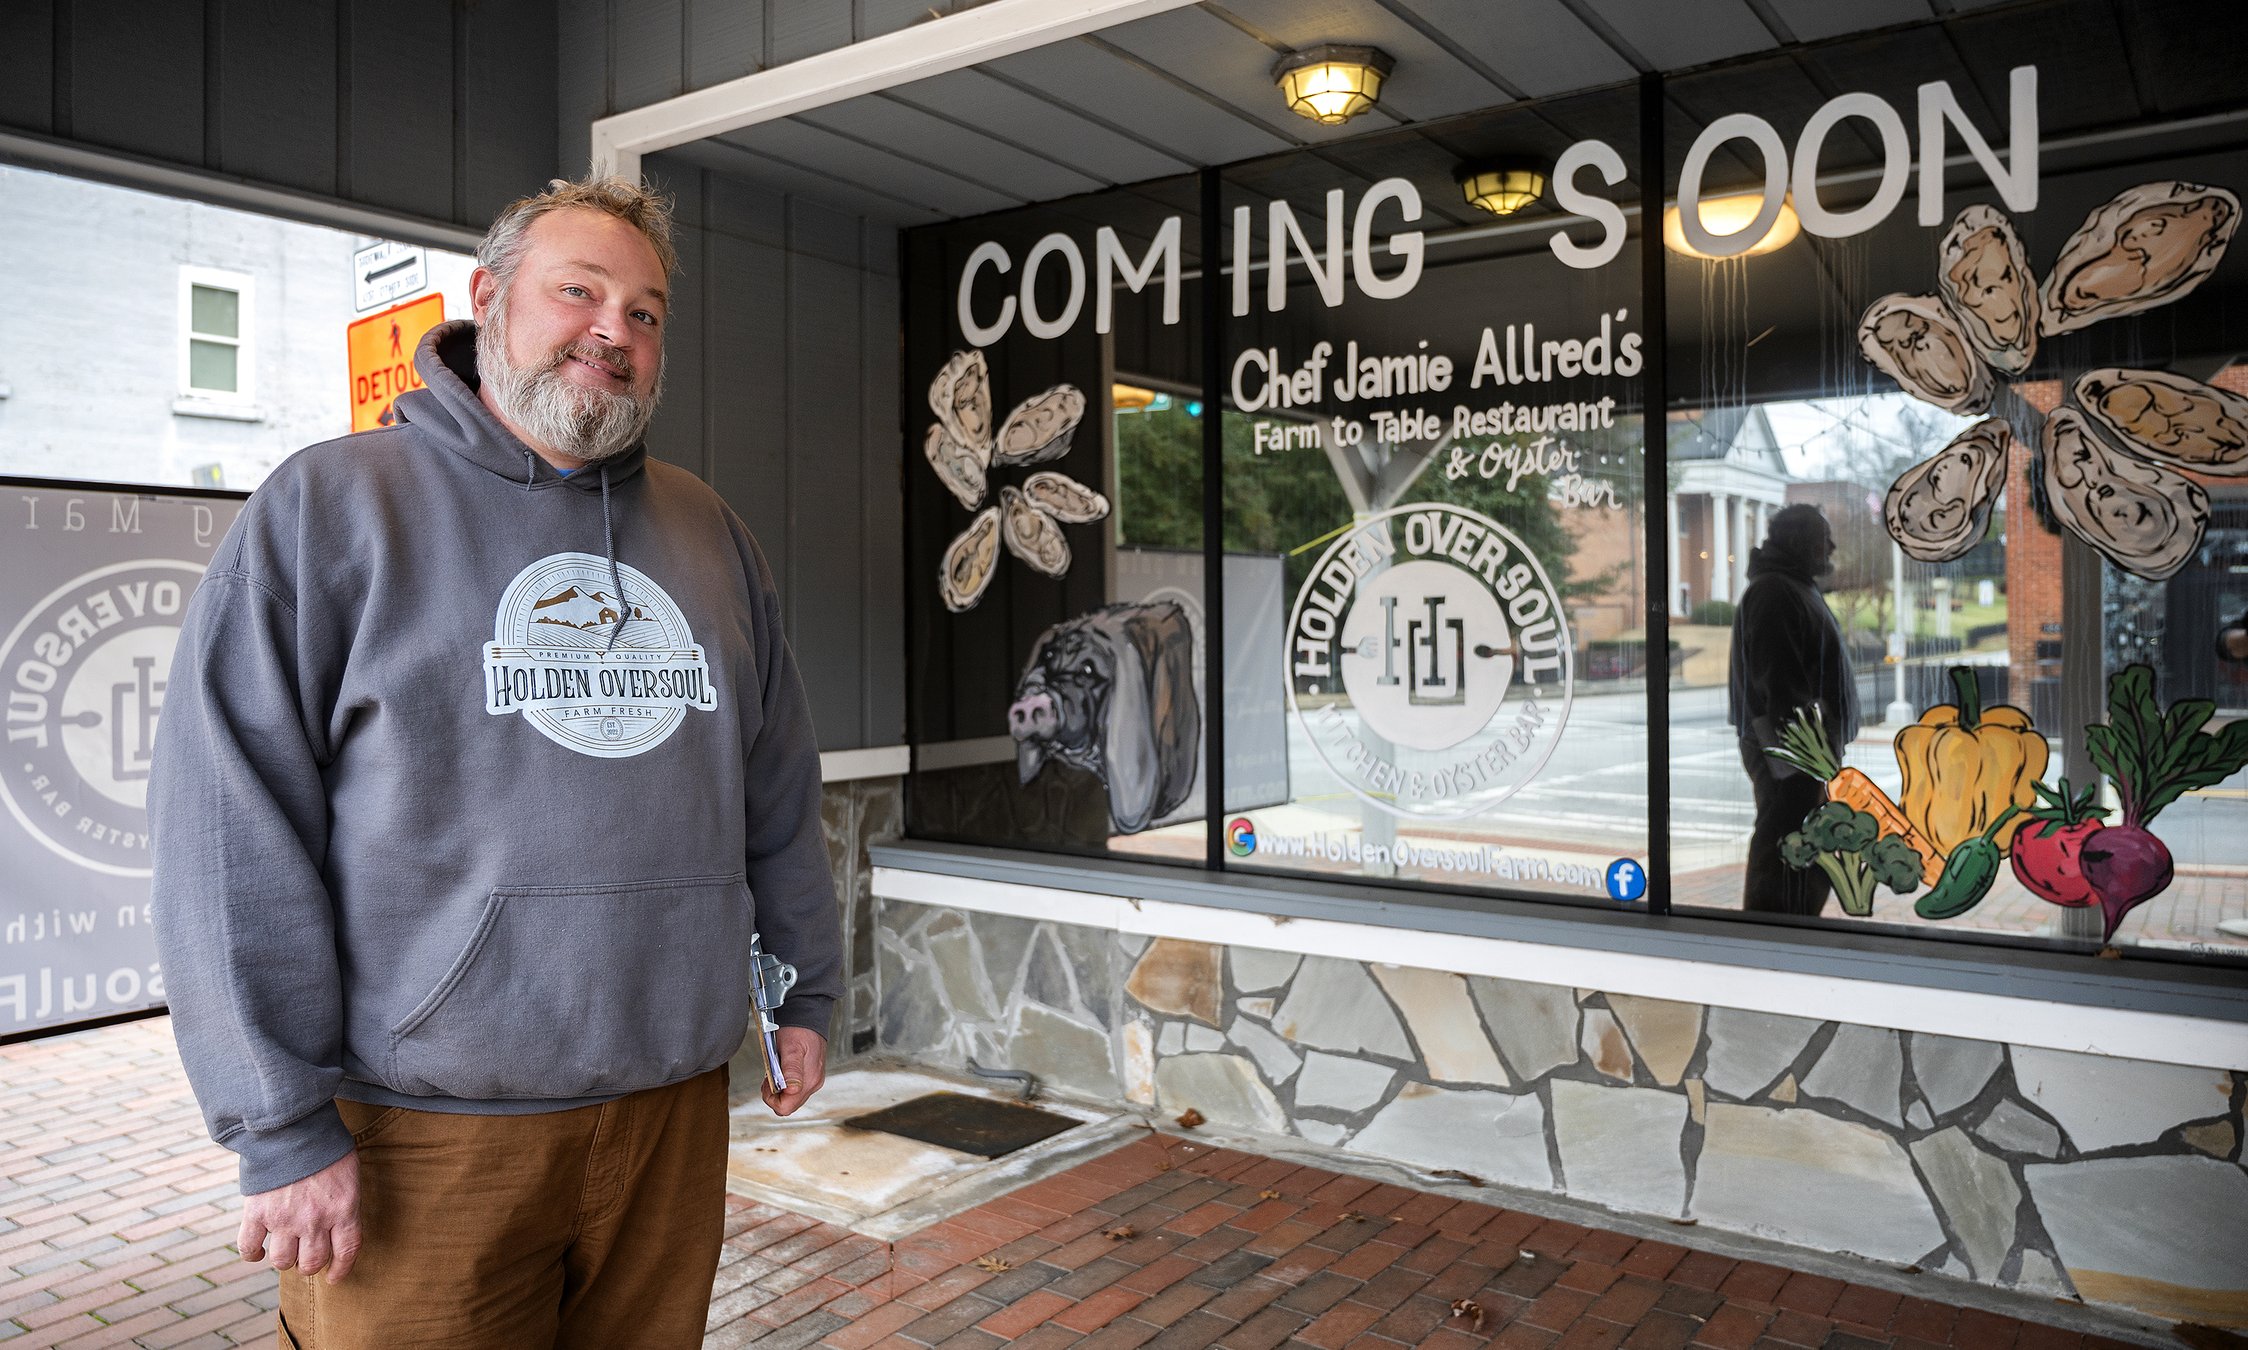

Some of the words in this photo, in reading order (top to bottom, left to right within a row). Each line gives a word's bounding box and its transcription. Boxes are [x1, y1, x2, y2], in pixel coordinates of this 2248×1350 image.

[956, 176, 1425, 348] COMING
[1549, 64, 2040, 270] SOON
[357, 361, 423, 405] DETOU
[1231, 341, 1333, 413] Chef
[1333, 340, 1454, 402] Jamie
[1470, 308, 1643, 389] Allred's
[1254, 421, 1321, 456] Farm
[1331, 415, 1364, 448] to
[1370, 408, 1441, 444] Table
[1453, 396, 1616, 440] Restaurant
[1446, 446, 1474, 481] &
[1478, 437, 1580, 493] Oyster
[1562, 474, 1623, 511] Bar
[1295, 520, 1397, 678] HOLDEN
[1404, 511, 1561, 685] OVERSOUL
[539, 651, 591, 660] PREMIUM
[616, 653, 662, 661] QUALITY
[491, 665, 593, 708] HOLDEN
[599, 667, 712, 705] OVERSOUL
[564, 707, 602, 718] FARM
[611, 706, 652, 716] FRESH
[1317, 702, 1405, 797] KITCHEN
[1411, 774, 1429, 799] &
[1431, 745, 1519, 799] OYSTER
[1507, 699, 1550, 754] BAR
